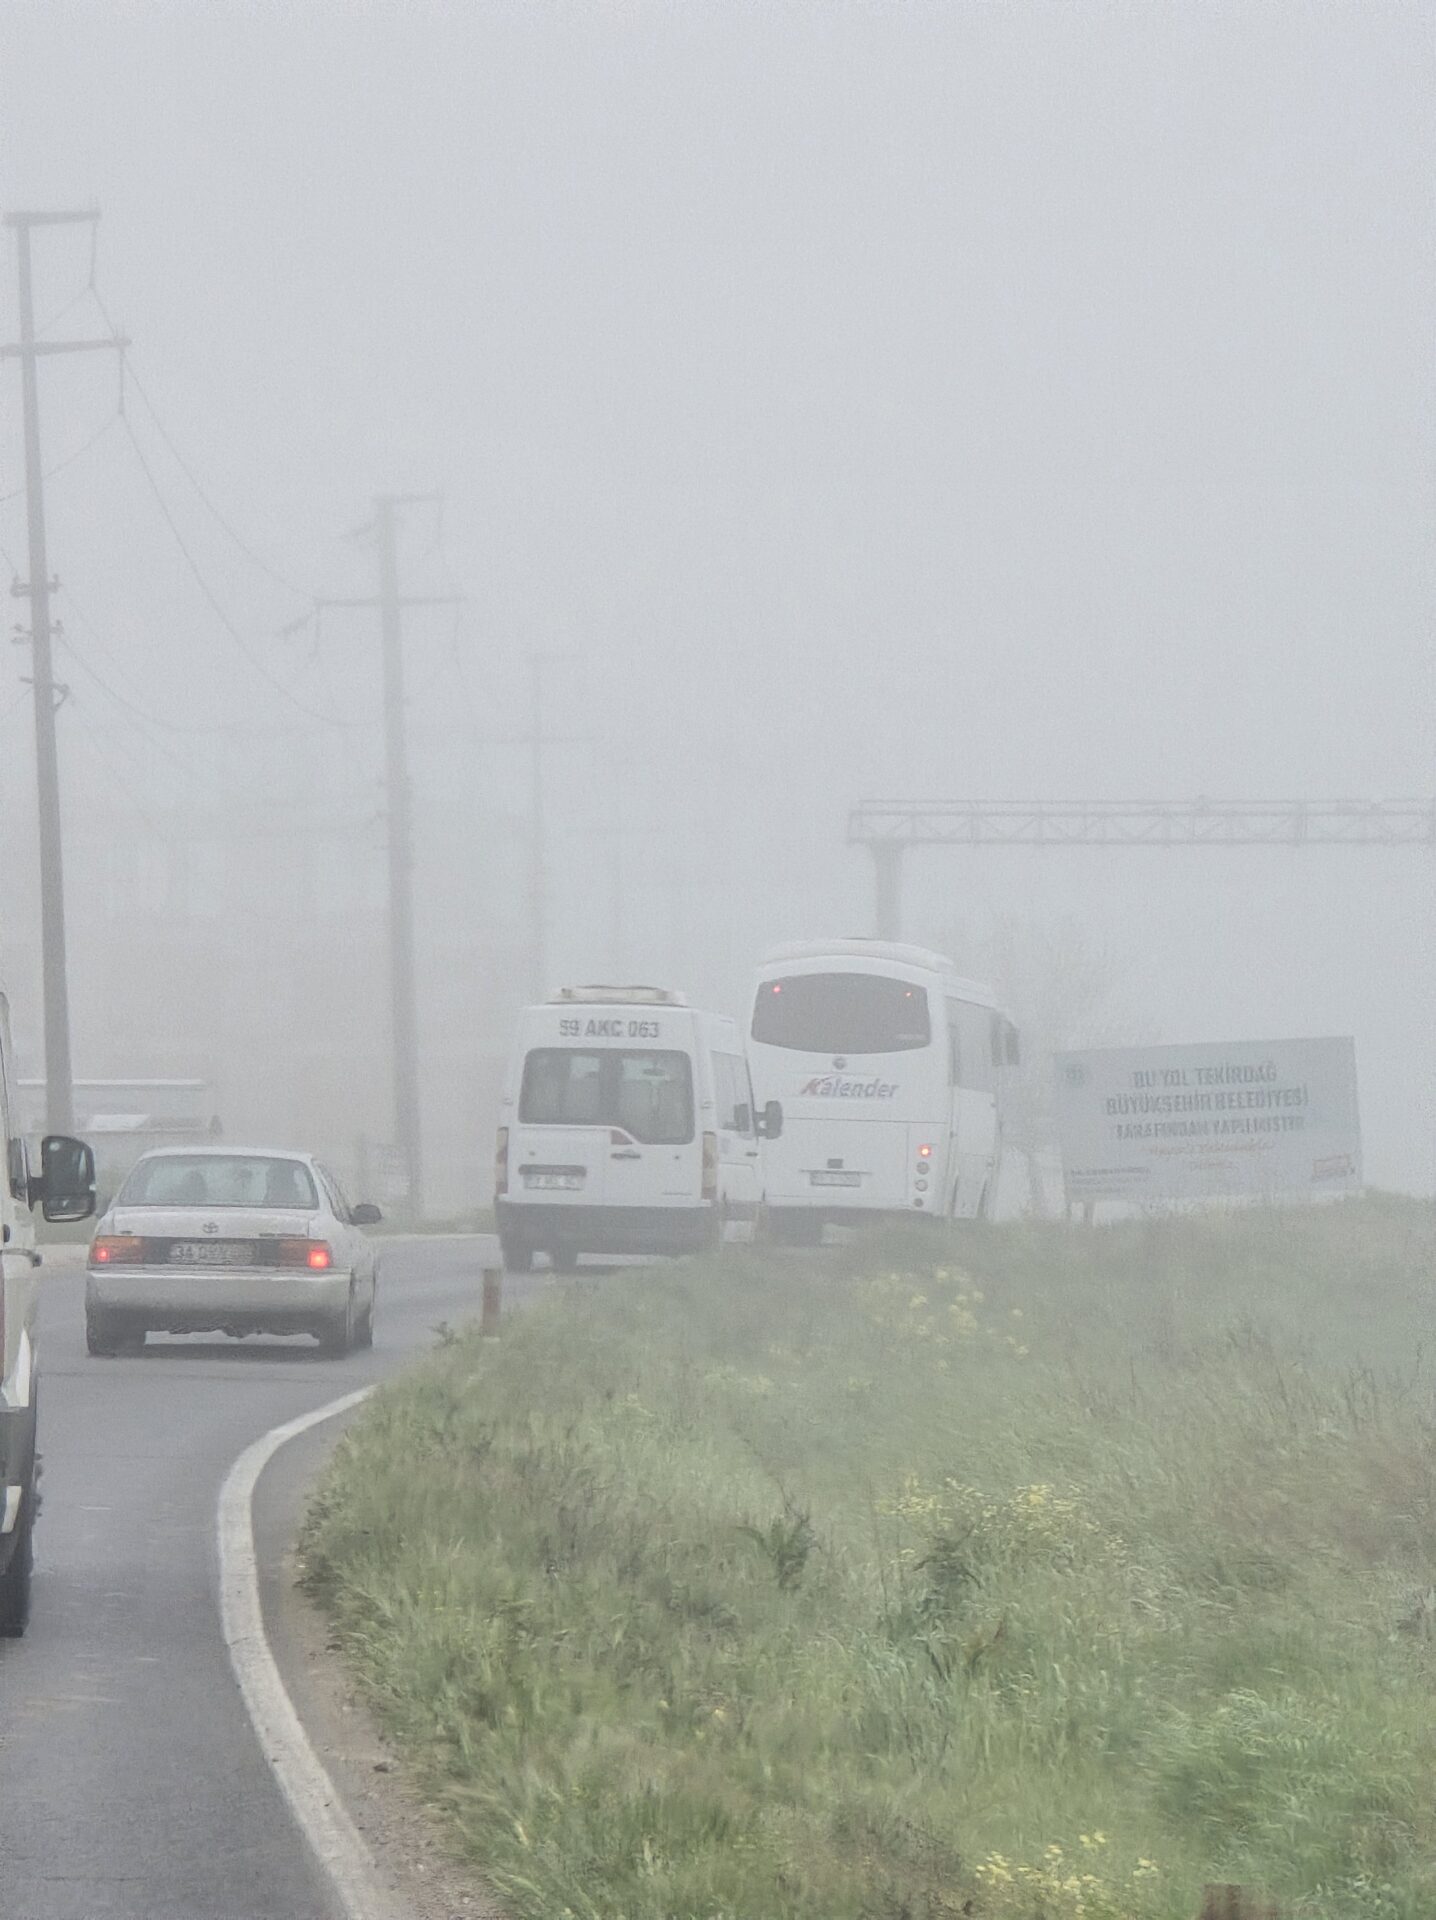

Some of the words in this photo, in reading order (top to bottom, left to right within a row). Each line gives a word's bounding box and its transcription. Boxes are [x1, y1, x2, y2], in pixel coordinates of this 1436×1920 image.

[559, 1019, 579, 1037] 59
[584, 1019, 622, 1037] AKC
[627, 1020, 660, 1038] 063
[1161, 1068, 1189, 1087] YOL
[1195, 1061, 1277, 1086] TEKİRDAĞ
[801, 1075, 899, 1098] Kalender
